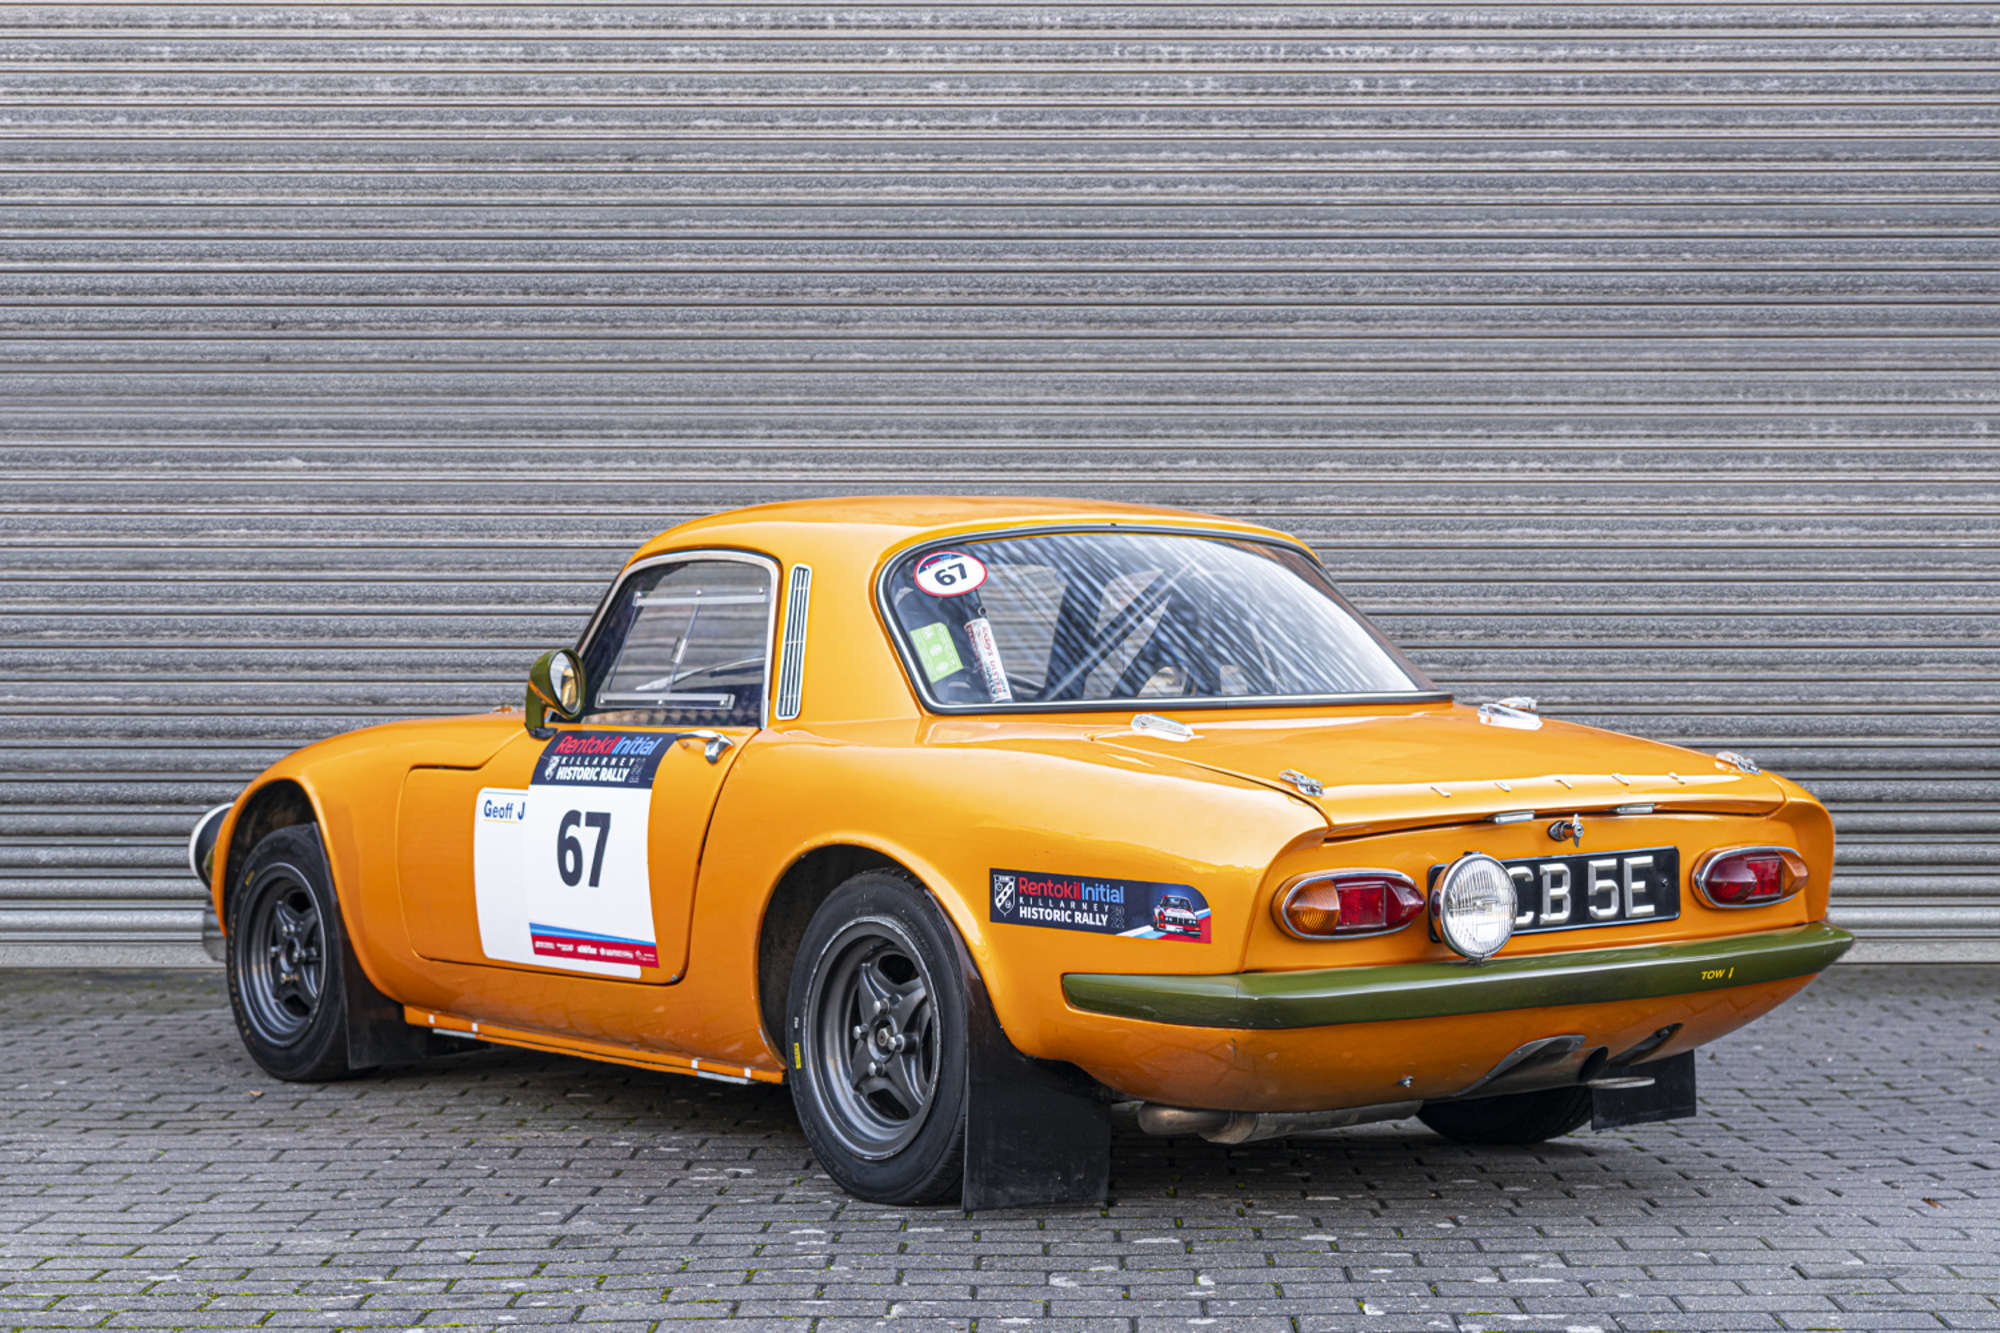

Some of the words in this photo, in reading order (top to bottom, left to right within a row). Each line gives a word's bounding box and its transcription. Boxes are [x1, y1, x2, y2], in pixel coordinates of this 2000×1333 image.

[934, 562, 967, 586] 67
[560, 756, 636, 767] KILLARNEY
[555, 766, 601, 781] HISTORIC
[598, 768, 631, 783] RALLY
[483, 799, 515, 819] Geoff
[517, 801, 526, 820] J
[556, 809, 612, 888] 67
[1588, 855, 1656, 920] 5E
[1019, 896, 1110, 913] KILLARNEY
[1019, 906, 1073, 923] HISTORIC
[1074, 911, 1109, 927] RALLY
[1701, 969, 1727, 981] TOW
